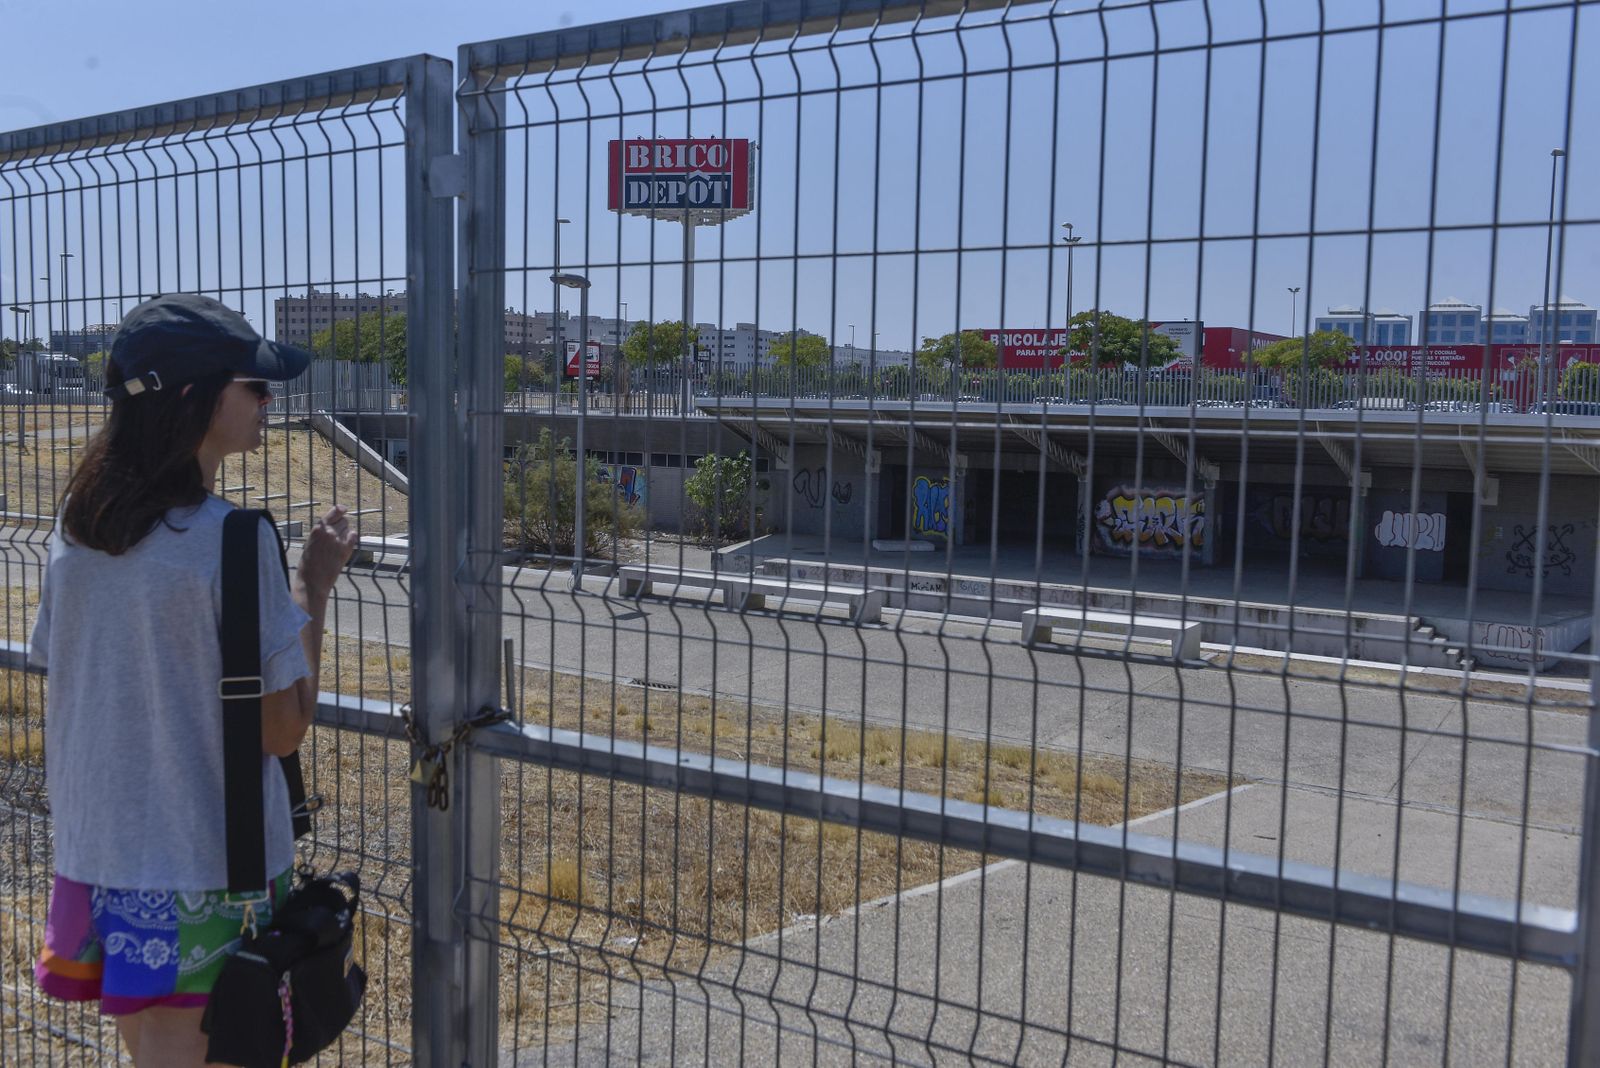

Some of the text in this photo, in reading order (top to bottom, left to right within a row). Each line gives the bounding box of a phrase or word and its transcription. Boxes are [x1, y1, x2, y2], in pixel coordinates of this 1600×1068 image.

[628, 144, 729, 168] BRICO
[628, 169, 728, 204] DEPÔT
[990, 333, 1066, 347] BRICOLAJE
